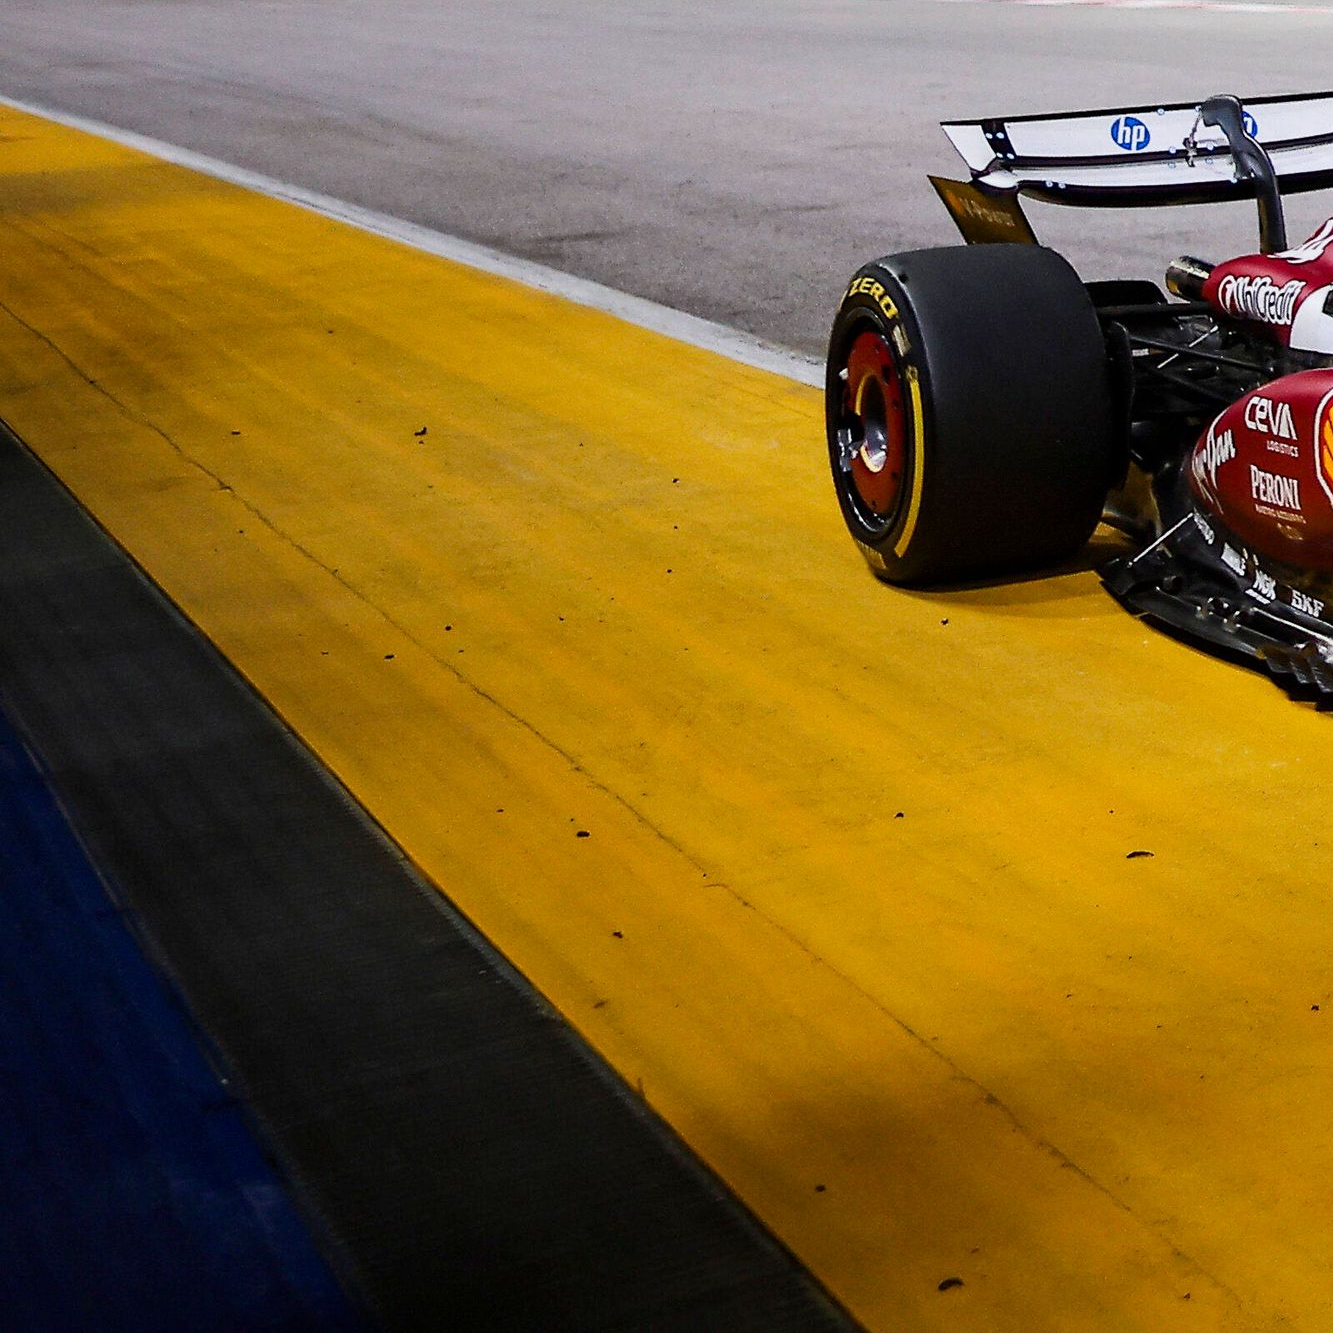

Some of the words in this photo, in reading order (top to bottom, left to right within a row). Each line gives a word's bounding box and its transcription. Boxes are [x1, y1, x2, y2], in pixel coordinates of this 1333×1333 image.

[848, 276, 899, 320] ZERO
[1249, 464, 1302, 511] PERONI
[1290, 588, 1325, 618] SKF
